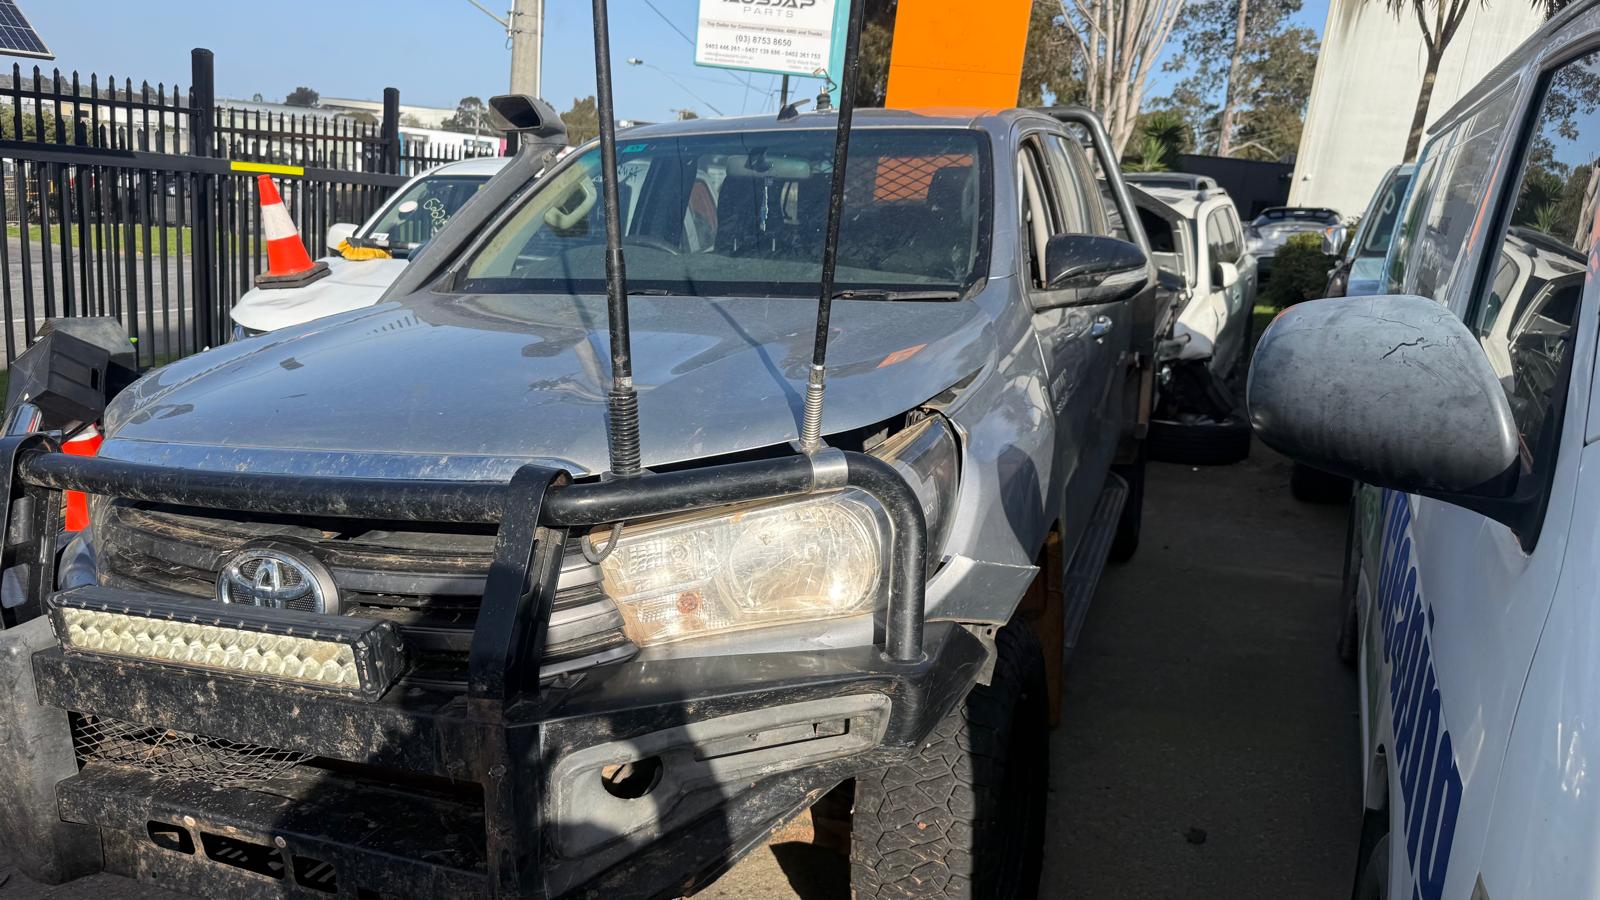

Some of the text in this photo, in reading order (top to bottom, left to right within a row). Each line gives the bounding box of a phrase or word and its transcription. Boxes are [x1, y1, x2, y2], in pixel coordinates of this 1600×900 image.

[722, 0, 815, 9] JAP
[743, 6, 794, 18] PARTS
[735, 34, 792, 47] (03) 8753 8650
